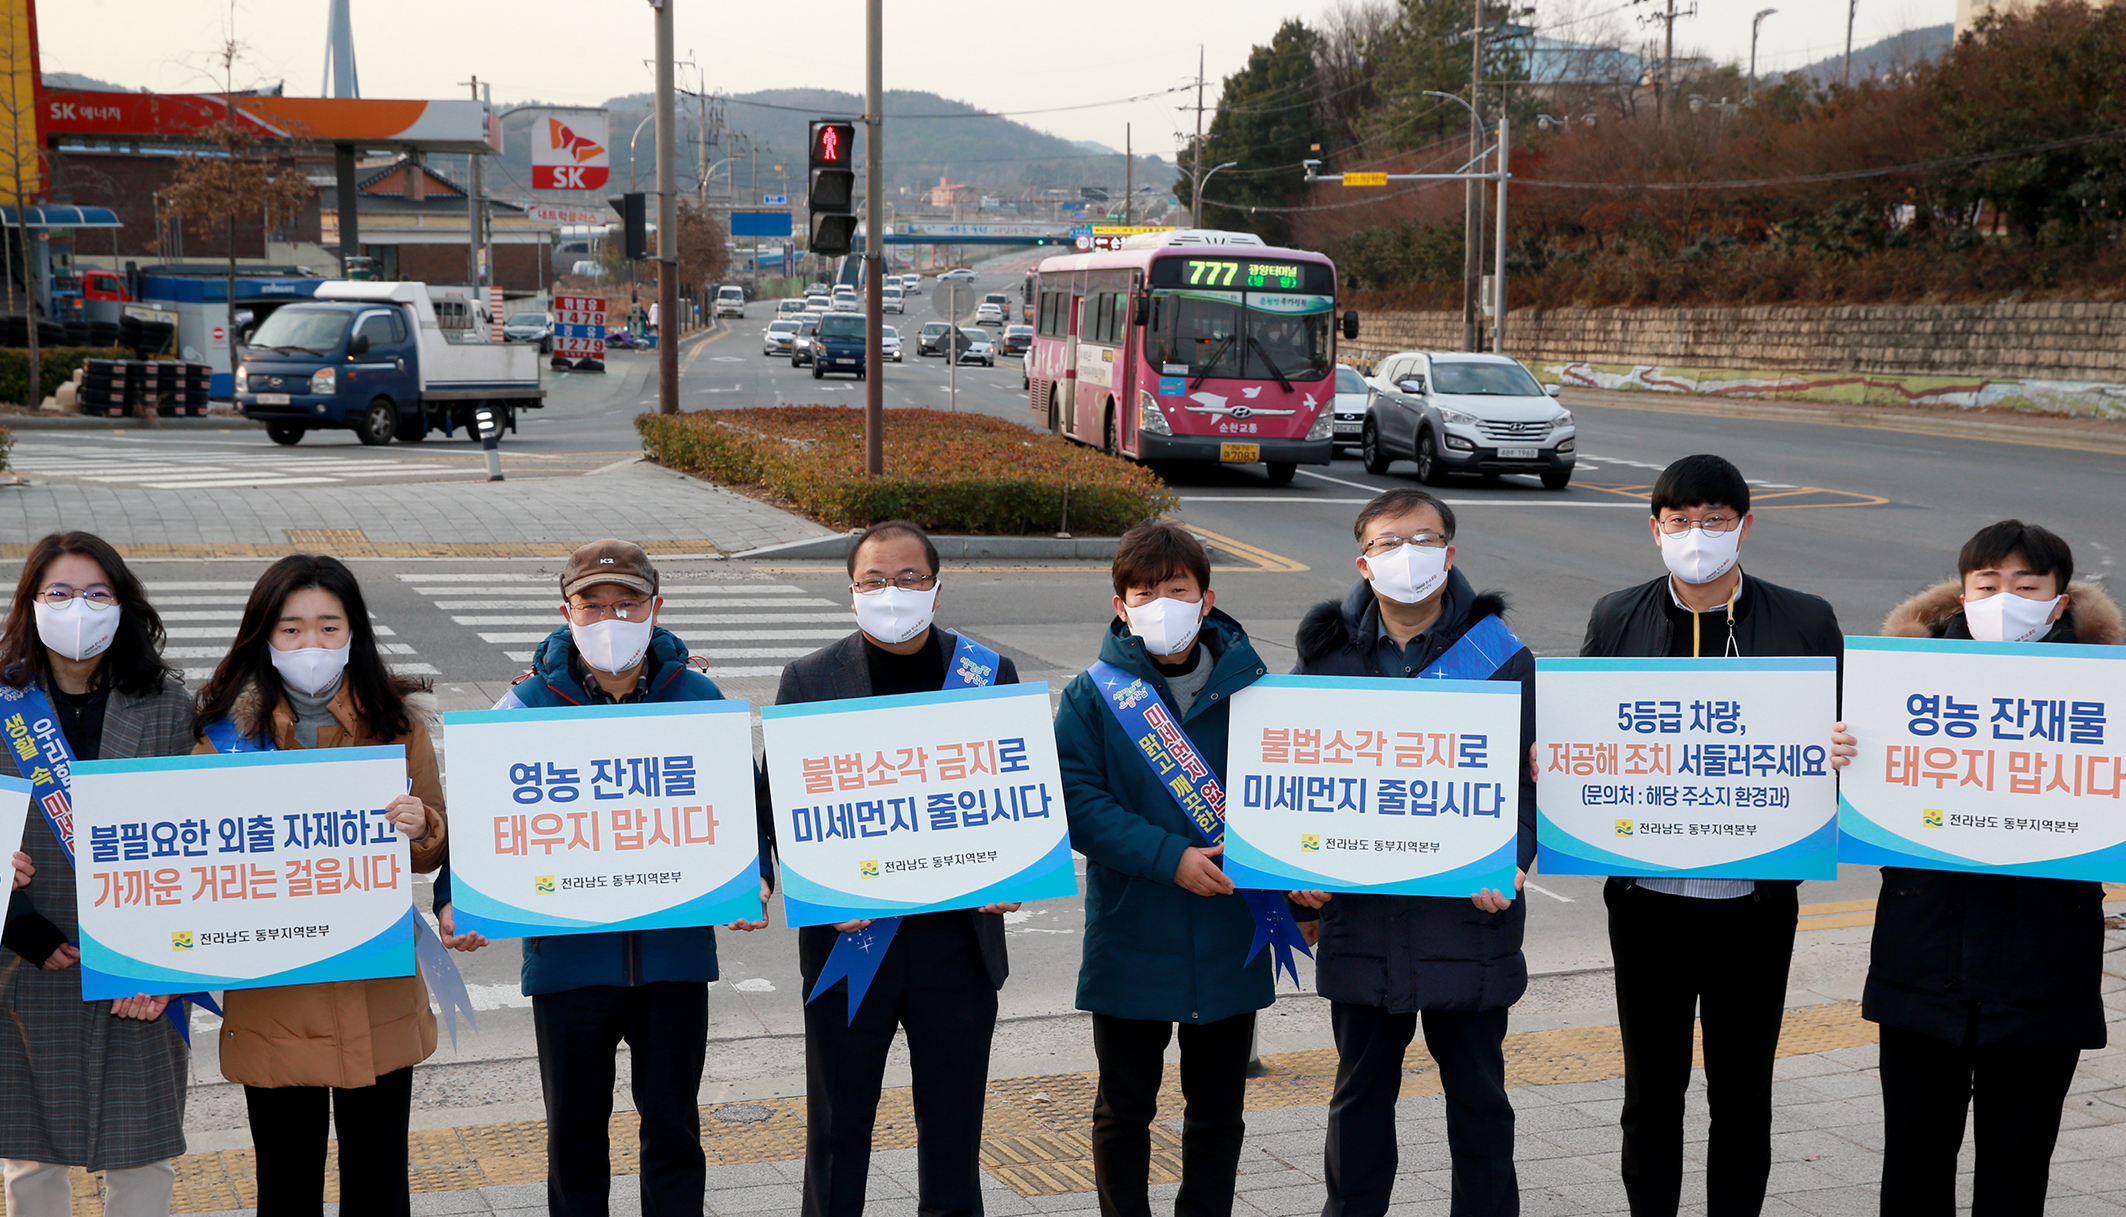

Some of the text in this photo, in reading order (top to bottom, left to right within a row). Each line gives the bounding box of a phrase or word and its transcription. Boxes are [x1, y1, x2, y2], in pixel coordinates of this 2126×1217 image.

[50, 103, 121, 120] SK 에너지
[552, 166, 586, 188] SK
[538, 209, 598, 223] 내트럭플러스
[1188, 260, 1238, 286] 777
[1248, 264, 1298, 278] 광양터미널
[564, 298, 598, 310] 휘발유
[558, 311, 604, 326] 1479
[558, 338, 604, 352] 1279
[1219, 423, 1258, 434] 순천교통
[1231, 451, 1256, 462] 7083
[1618, 700, 1746, 736] 5등급 차량,
[1906, 693, 2106, 745] 영농 잔재물
[4, 712, 39, 762] 생활
[30, 765, 54, 786] 속
[1142, 703, 1208, 784] 미세먼지
[1260, 727, 1489, 769] 불법소각 금지로
[802, 737, 1030, 794] 불법소각 금지로
[1548, 743, 1826, 777] 저공해 조치 서둘러주세요
[1885, 744, 2126, 799] 태우지 맙시다
[509, 755, 697, 805] 영농 잔재물
[1138, 732, 1218, 834] 맑고 깨끗한
[1244, 774, 1505, 818] 미세먼지 줄입시다
[1582, 785, 1634, 807] (문의처
[1646, 785, 1678, 806] 해당
[1682, 786, 1731, 807] 주소지
[1735, 786, 1790, 808] 환경과)
[41, 790, 75, 855] 미세
[792, 782, 1052, 843] 미세먼지 줄입시다
[1950, 813, 2079, 834] 전라남도 동부지역본부
[89, 808, 398, 863] 불필요한 외출 자제하고
[493, 805, 720, 856] 태우지 맙시다
[1639, 822, 1757, 836] 전라남도 동부지역본부
[1326, 838, 1440, 854] 전라남도 동부지역본부
[884, 850, 998, 873] 전라남도 동부지역본부
[92, 854, 401, 909] 가까운 거리는 걸읍시다
[561, 871, 682, 890] 전라남도 동부지역본부
[200, 924, 330, 945] 전라남도 동부지역본부
